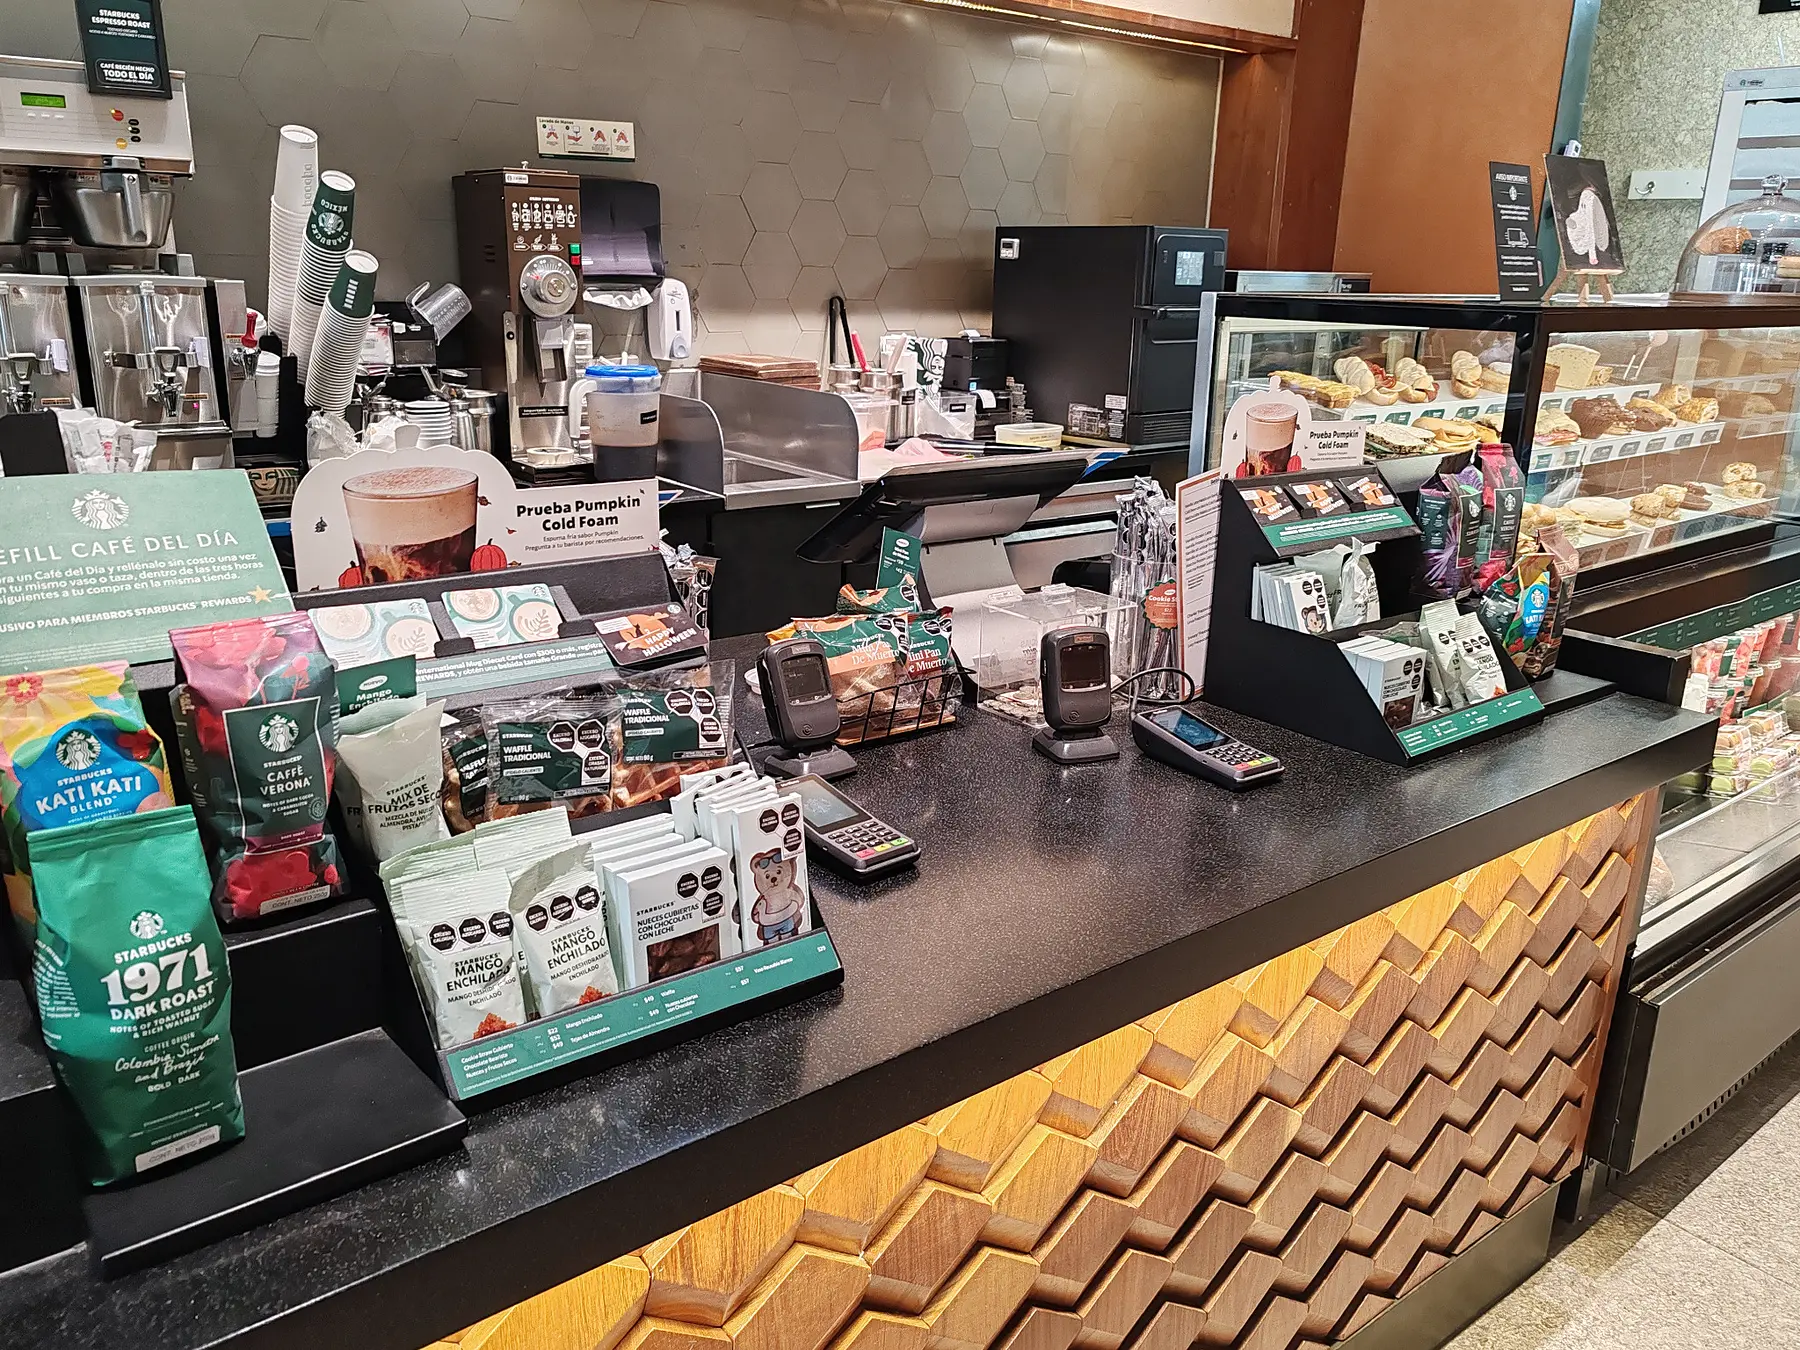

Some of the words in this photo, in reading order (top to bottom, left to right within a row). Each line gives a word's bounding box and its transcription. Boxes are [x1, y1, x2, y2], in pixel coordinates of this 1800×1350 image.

[92, 16, 126, 26] ESPRESSO
[128, 20, 150, 28] ROAST
[99, 9, 140, 20] STARBUCKS
[103, 70, 128, 78] TODO
[138, 72, 154, 80] DÍA
[311, 223, 349, 246] STARBUCKS
[1310, 431, 1331, 439] Prueba
[516, 502, 572, 517] Prueba
[575, 495, 641, 513] Pumpkin
[542, 517, 575, 532] Cold
[579, 515, 619, 528] Foam
[71, 536, 136, 558] CAFÉ
[144, 535, 189, 552] DEL
[196, 529, 239, 548] DÍA
[524, 543, 551, 552] Pregunta
[564, 540, 584, 548] barista
[9, 584, 22, 592] tu
[25, 580, 67, 592] mismo
[69, 577, 97, 586] vaso
[109, 572, 138, 582] taza,
[139, 569, 177, 580] dentro
[178, 566, 194, 575] de
[195, 564, 211, 574] las
[212, 562, 234, 572] tres
[234, 560, 264, 570] horas
[17, 574, 32, 582] un
[34, 569, 62, 580] Café
[65, 566, 84, 577] del
[85, 565, 105, 575] Día
[107, 566, 114, 575] y
[117, 560, 166, 572] rellénalo
[168, 558, 184, 568] sin
[186, 556, 215, 566] costo
[217, 554, 237, 562] una
[239, 553, 257, 561] vez
[61, 589, 69, 597] a
[71, 587, 84, 596] tu
[86, 583, 132, 595] compra
[134, 581, 148, 590] en
[150, 578, 161, 588] la
[163, 575, 201, 586] misma
[202, 572, 240, 582] tienda.
[37, 617, 69, 628] PARA
[70, 609, 134, 624] MIEMBROS
[200, 596, 252, 608] REWARDS
[642, 628, 698, 657] HALLOWEEN
[644, 627, 676, 645] HAPPY
[551, 652, 577, 662] Grande
[924, 648, 941, 659] Pan
[915, 658, 947, 672] Muerto
[356, 689, 392, 702] Mango
[624, 708, 651, 716] WAFFLE
[624, 714, 670, 724] TRADICIONAL
[503, 745, 533, 754] WAFFLE
[503, 752, 552, 763] TRADICIONAL
[57, 768, 113, 787] STARBUCKS
[267, 765, 304, 782] CAFFÈ
[260, 777, 311, 796] VERONA
[390, 790, 412, 806] MIX
[414, 784, 430, 797] DE
[36, 786, 86, 816] KATI
[90, 776, 141, 797] KATI
[70, 798, 113, 814] BLEND
[368, 800, 416, 814] FRUTOS
[385, 812, 409, 822] MEZCLA
[636, 901, 676, 916] STARBUCKS
[637, 914, 664, 928] NUECES
[664, 903, 700, 920] CUBIERTAS
[638, 924, 654, 934] CON
[654, 912, 693, 930] CHOCOLATE
[550, 926, 591, 946] STARBUCKS
[638, 932, 654, 941] CON
[654, 926, 675, 936] LECHE
[114, 932, 192, 964] STARBUCKS
[552, 930, 596, 956] MANGO
[454, 953, 500, 968] STARBUCKS
[547, 937, 606, 970] ENCHILADO
[101, 942, 213, 1006] 1971
[455, 958, 504, 978] MANGO
[550, 967, 572, 980] MANGO
[568, 964, 600, 982] ENCHILADO
[446, 966, 511, 992] ENCHILADO
[110, 1002, 157, 1020] DARK
[160, 980, 214, 1012] ROAST
[448, 992, 472, 1004] MANGO
[468, 990, 502, 1006] ENCHILADO
[110, 1024, 138, 1034] NOTES
[140, 1022, 152, 1030] OF
[154, 1008, 191, 1026] TOASTED
[192, 998, 215, 1013] SUGAR
[133, 1031, 140, 1039] &
[142, 1025, 164, 1038] RICH
[165, 1012, 200, 1030] WALNUT
[548, 1027, 558, 1035] $22
[144, 1040, 170, 1052] COFFEE
[171, 1032, 196, 1046] ORIGIN
[135, 1067, 159, 1084] and
[163, 1052, 206, 1076] Brazil
[148, 1081, 172, 1092] BOLD
[178, 1070, 200, 1084] DARK
